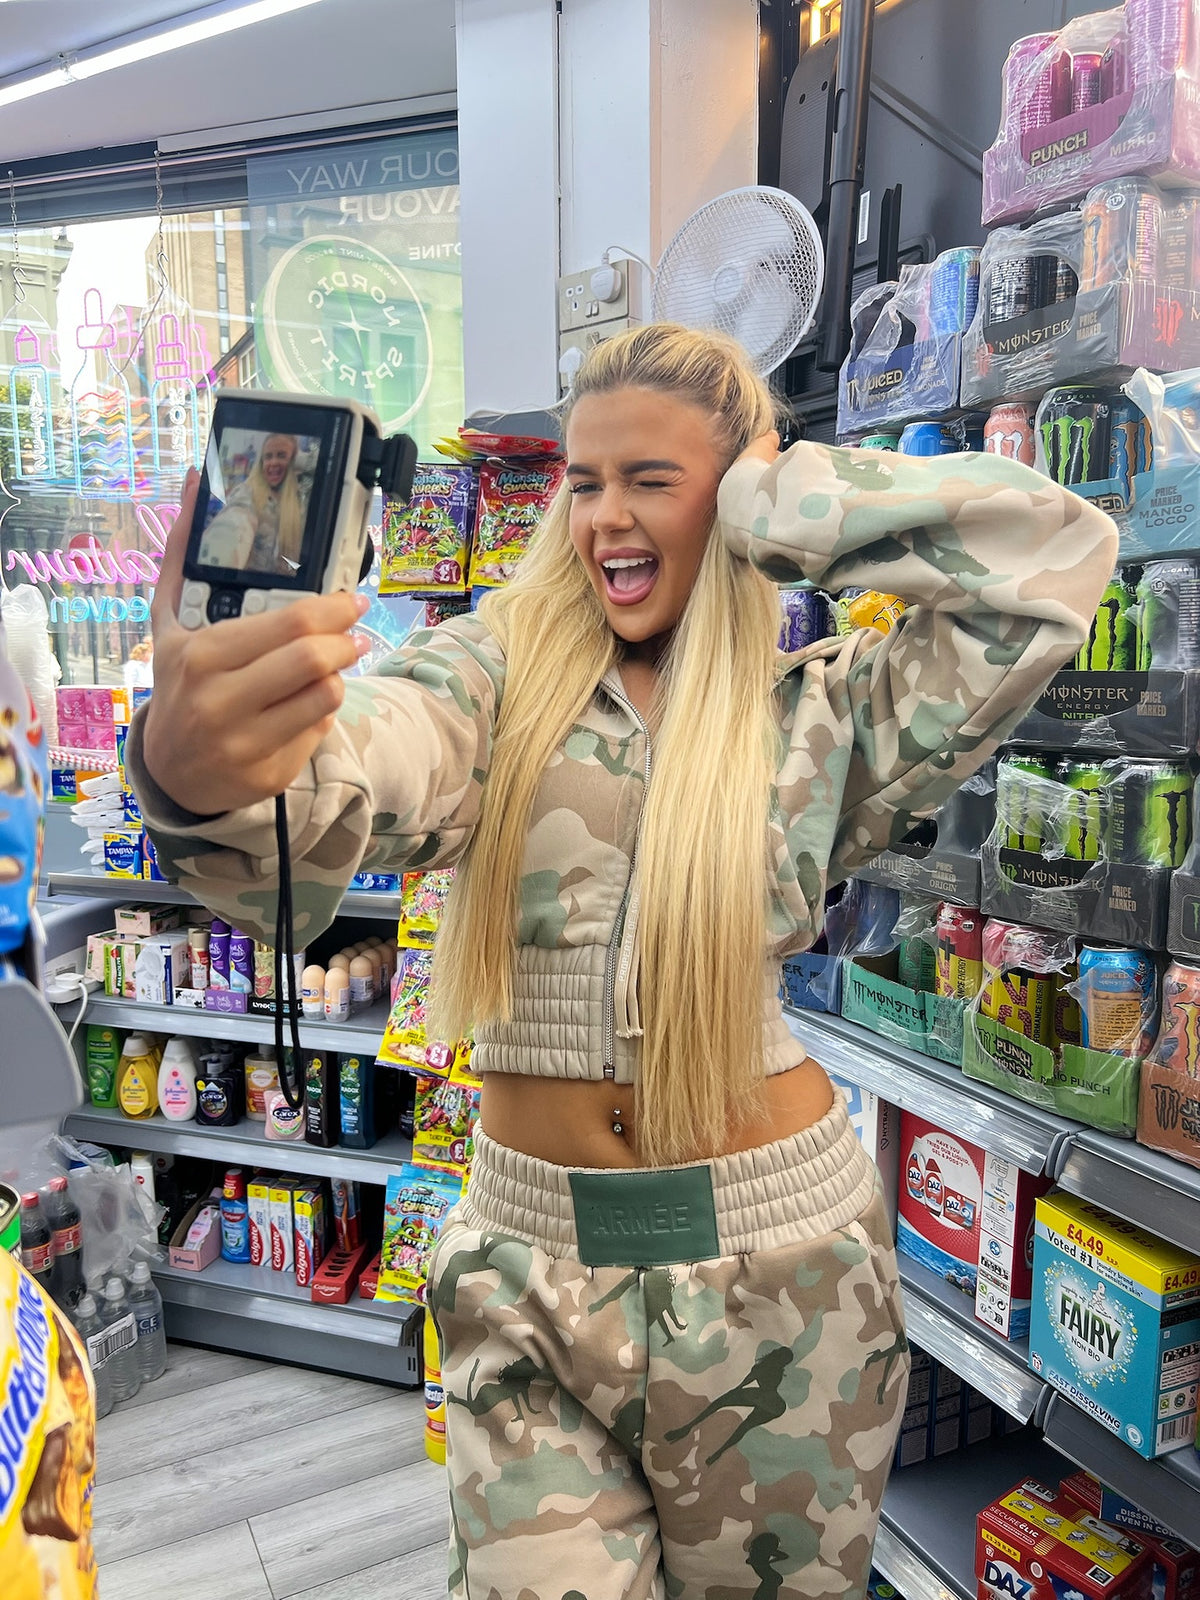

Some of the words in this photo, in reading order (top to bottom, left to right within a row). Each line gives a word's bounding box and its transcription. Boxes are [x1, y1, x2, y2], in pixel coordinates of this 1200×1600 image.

[1030, 129, 1089, 167] PUNCH
[999, 319, 1071, 353] MONSTER
[861, 369, 904, 393] JUICED
[413, 474, 456, 487] onster
[498, 472, 551, 485] Monster
[413, 484, 451, 495] weets
[501, 482, 547, 495] Sweets
[1155, 485, 1178, 498] PRICE
[1150, 495, 1183, 508] MARKED
[1139, 503, 1195, 520] MANGO
[1145, 514, 1188, 529] LOCO
[440, 564, 459, 583] £1
[437, 601, 471, 615] Mons
[1042, 684, 1129, 702] MONSTER
[1140, 691, 1162, 704] PRICE
[1056, 702, 1111, 710] ENERGY
[1136, 703, 1167, 717] MARKED
[106, 846, 134, 856] TAMPAX
[929, 879, 958, 893] ORIGIN
[1022, 868, 1106, 892] MONSTER
[1111, 885, 1132, 898] PRICE
[1108, 896, 1137, 912] MARKED
[252, 1001, 271, 1009] LYNX
[866, 987, 929, 1023] MONSTER
[429, 1045, 449, 1067] £1
[996, 1040, 1031, 1067] PUNCH
[340, 1085, 359, 1094] RADOX
[1070, 1075, 1111, 1096] PUNCH
[202, 1092, 224, 1100] Carex
[273, 1109, 299, 1118] Carex
[926, 1138, 941, 1150] TRIED
[940, 1147, 952, 1157] OUR
[931, 1147, 942, 1157] GEL
[936, 1138, 950, 1149] HAVE
[949, 1145, 961, 1155] YOU
[908, 1169, 921, 1181] DAZ
[927, 1179, 941, 1192] DAZ
[399, 1190, 446, 1208] Monster
[945, 1198, 961, 1211] DAZ
[402, 1200, 441, 1218] Sweets
[251, 1226, 260, 1263] Colgate
[1047, 1228, 1077, 1258] Voted
[1080, 1250, 1094, 1269] #1
[1066, 1223, 1104, 1257] £4.49
[272, 1231, 281, 1268] Colgate
[296, 1239, 306, 1285] Colgate
[1096, 1259, 1118, 1278] laundry
[1117, 1272, 1134, 1287] brand
[1096, 1266, 1105, 1275] for
[1104, 1272, 1129, 1290] sensitive
[1164, 1270, 1198, 1291] £4.49
[313, 1283, 341, 1292] Colgate
[361, 1280, 378, 1289] Colg
[1059, 1292, 1121, 1361] FAIRY
[1071, 1336, 1087, 1352] NON
[1087, 1348, 1101, 1363] BIO
[1048, 1370, 1071, 1390] FAST
[1069, 1384, 1122, 1429] DISSOLVING
[1115, 1513, 1141, 1528] EVEN
[1142, 1521, 1154, 1531] IN
[984, 1560, 1034, 1600] DAZ
